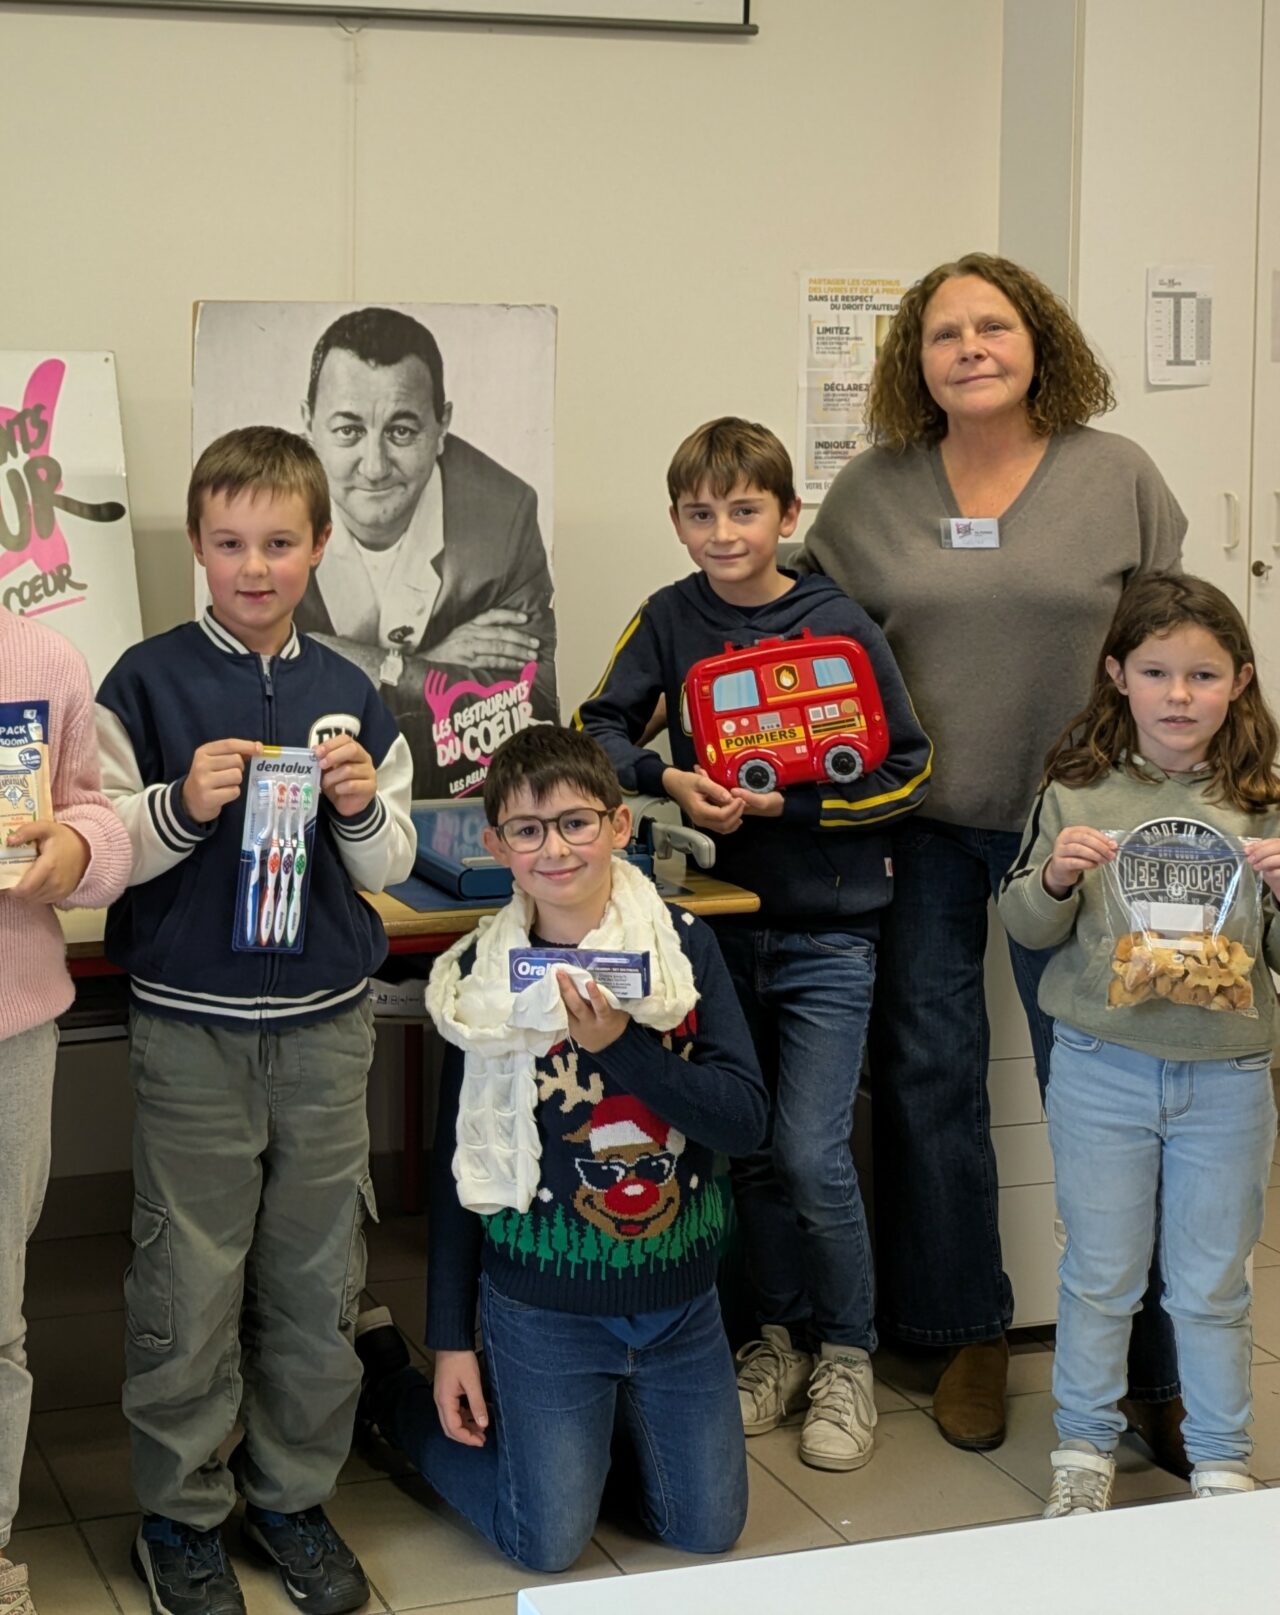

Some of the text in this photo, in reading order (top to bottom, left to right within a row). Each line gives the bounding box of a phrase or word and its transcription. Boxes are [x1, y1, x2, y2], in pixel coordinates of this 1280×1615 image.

[816, 327, 850, 335] LIMITEZ
[824, 382, 870, 391] DÉCLAREZ
[815, 441, 856, 449] INDIQUEZ
[432, 680, 529, 743] LES RESTAURANTS
[0, 737, 28, 746] 500ml
[437, 702, 553, 767] DU COEUR
[725, 728, 797, 749] POMPIERS
[256, 760, 313, 774] dentalux
[450, 779, 466, 793] LES
[1184, 824, 1197, 837] IN
[1124, 856, 1159, 890] LEE
